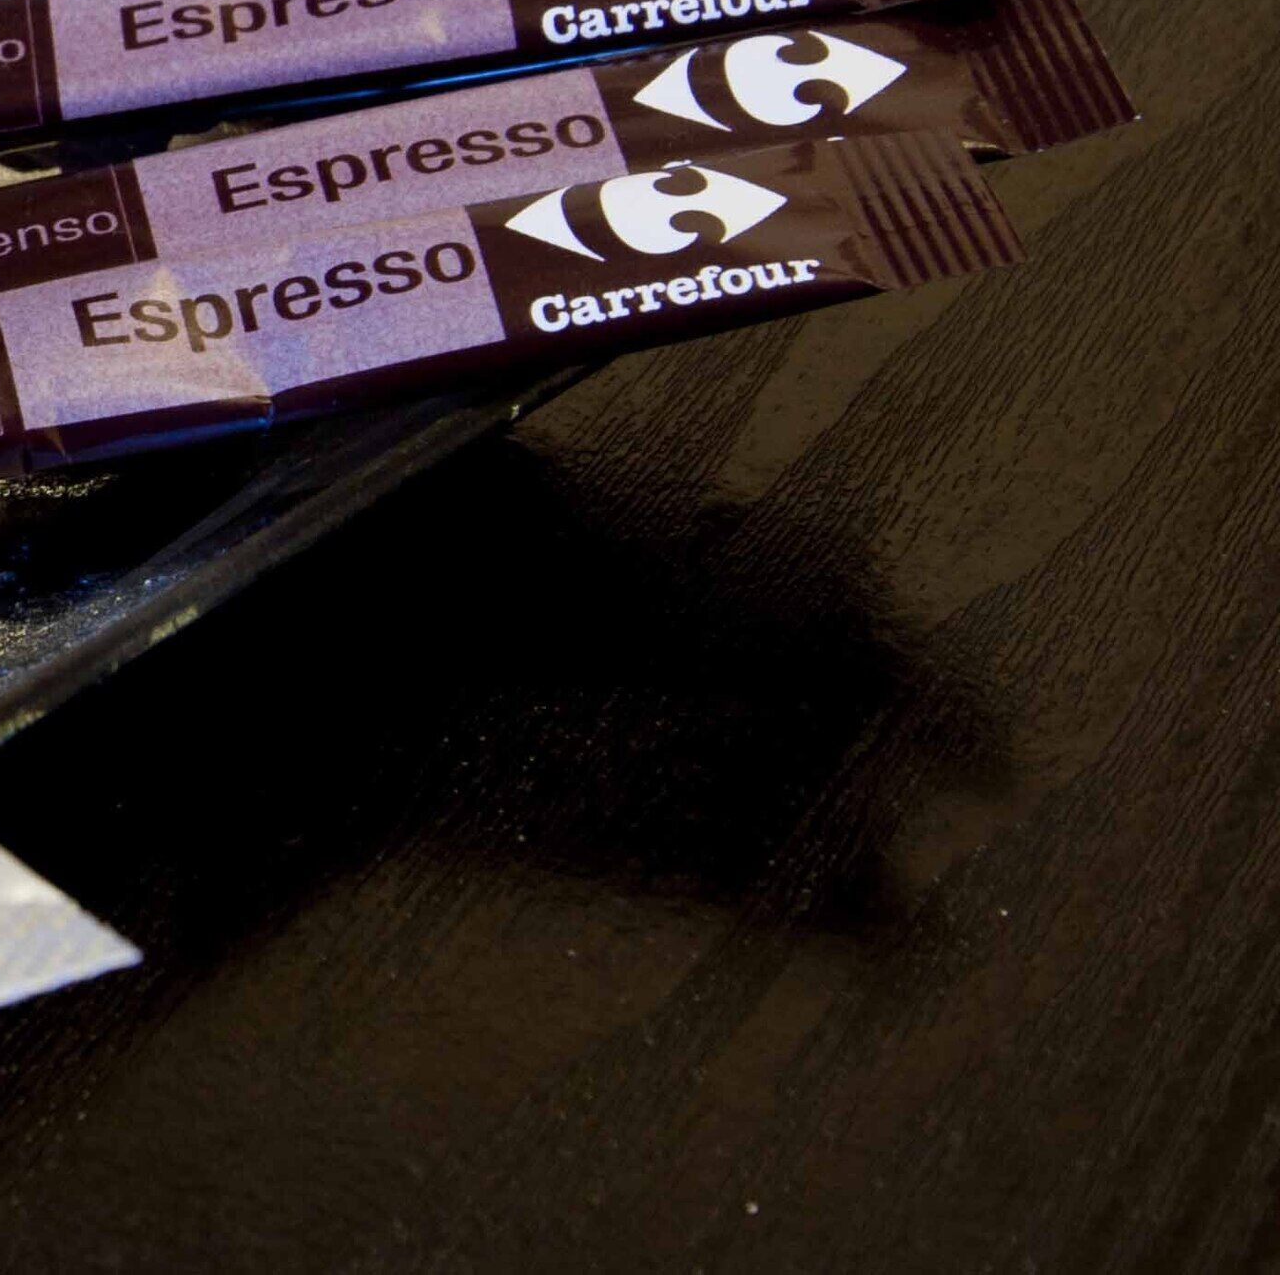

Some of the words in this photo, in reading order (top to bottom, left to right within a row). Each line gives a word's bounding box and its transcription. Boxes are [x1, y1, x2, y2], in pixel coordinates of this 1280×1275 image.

[211, 113, 608, 216] Espresso
[70, 239, 477, 353] Espresso
[529, 258, 822, 333] Carrefour
